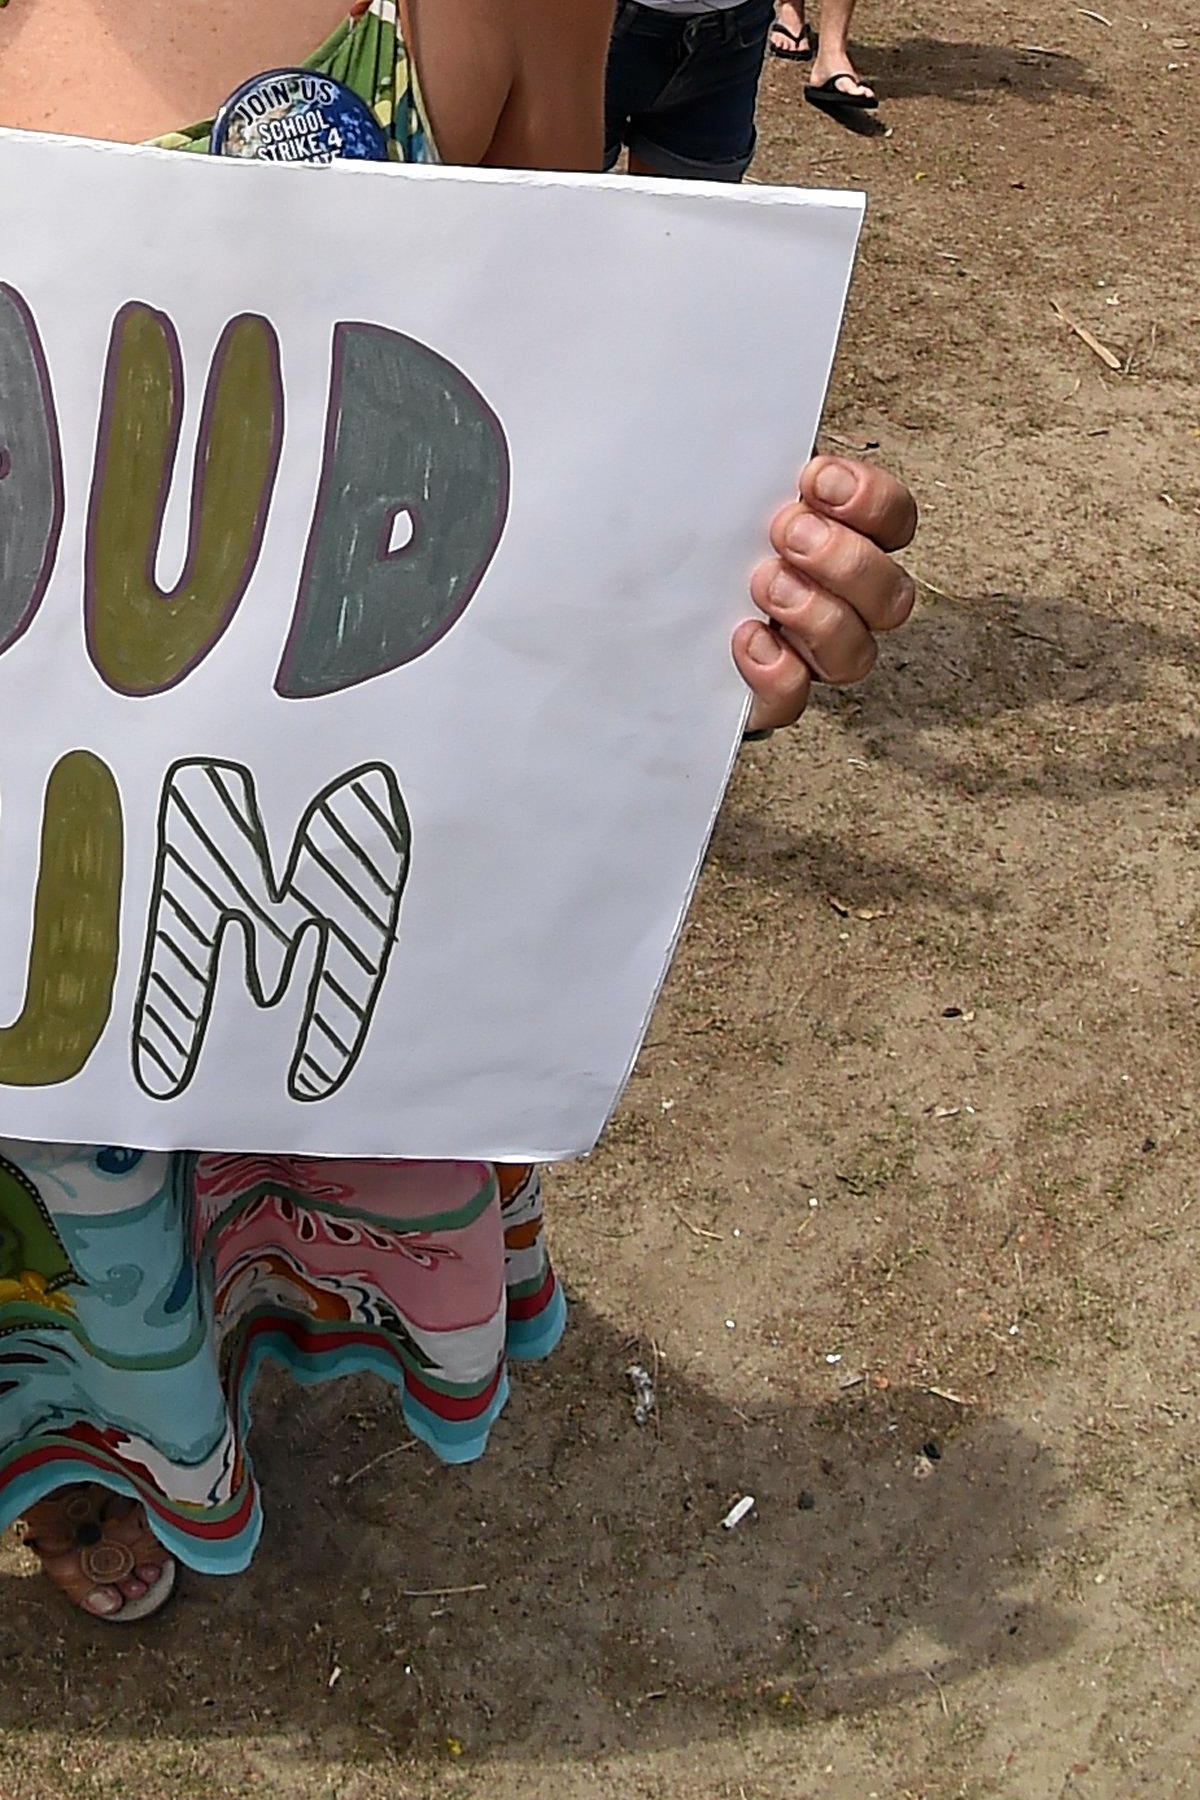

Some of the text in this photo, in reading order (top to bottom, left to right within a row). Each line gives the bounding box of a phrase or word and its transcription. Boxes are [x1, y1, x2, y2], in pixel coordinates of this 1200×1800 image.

[235, 79, 334, 127] JOIN US
[257, 132, 322, 162] STRIKE
[328, 126, 343, 148] 4
[258, 109, 330, 144] SCHOOL
